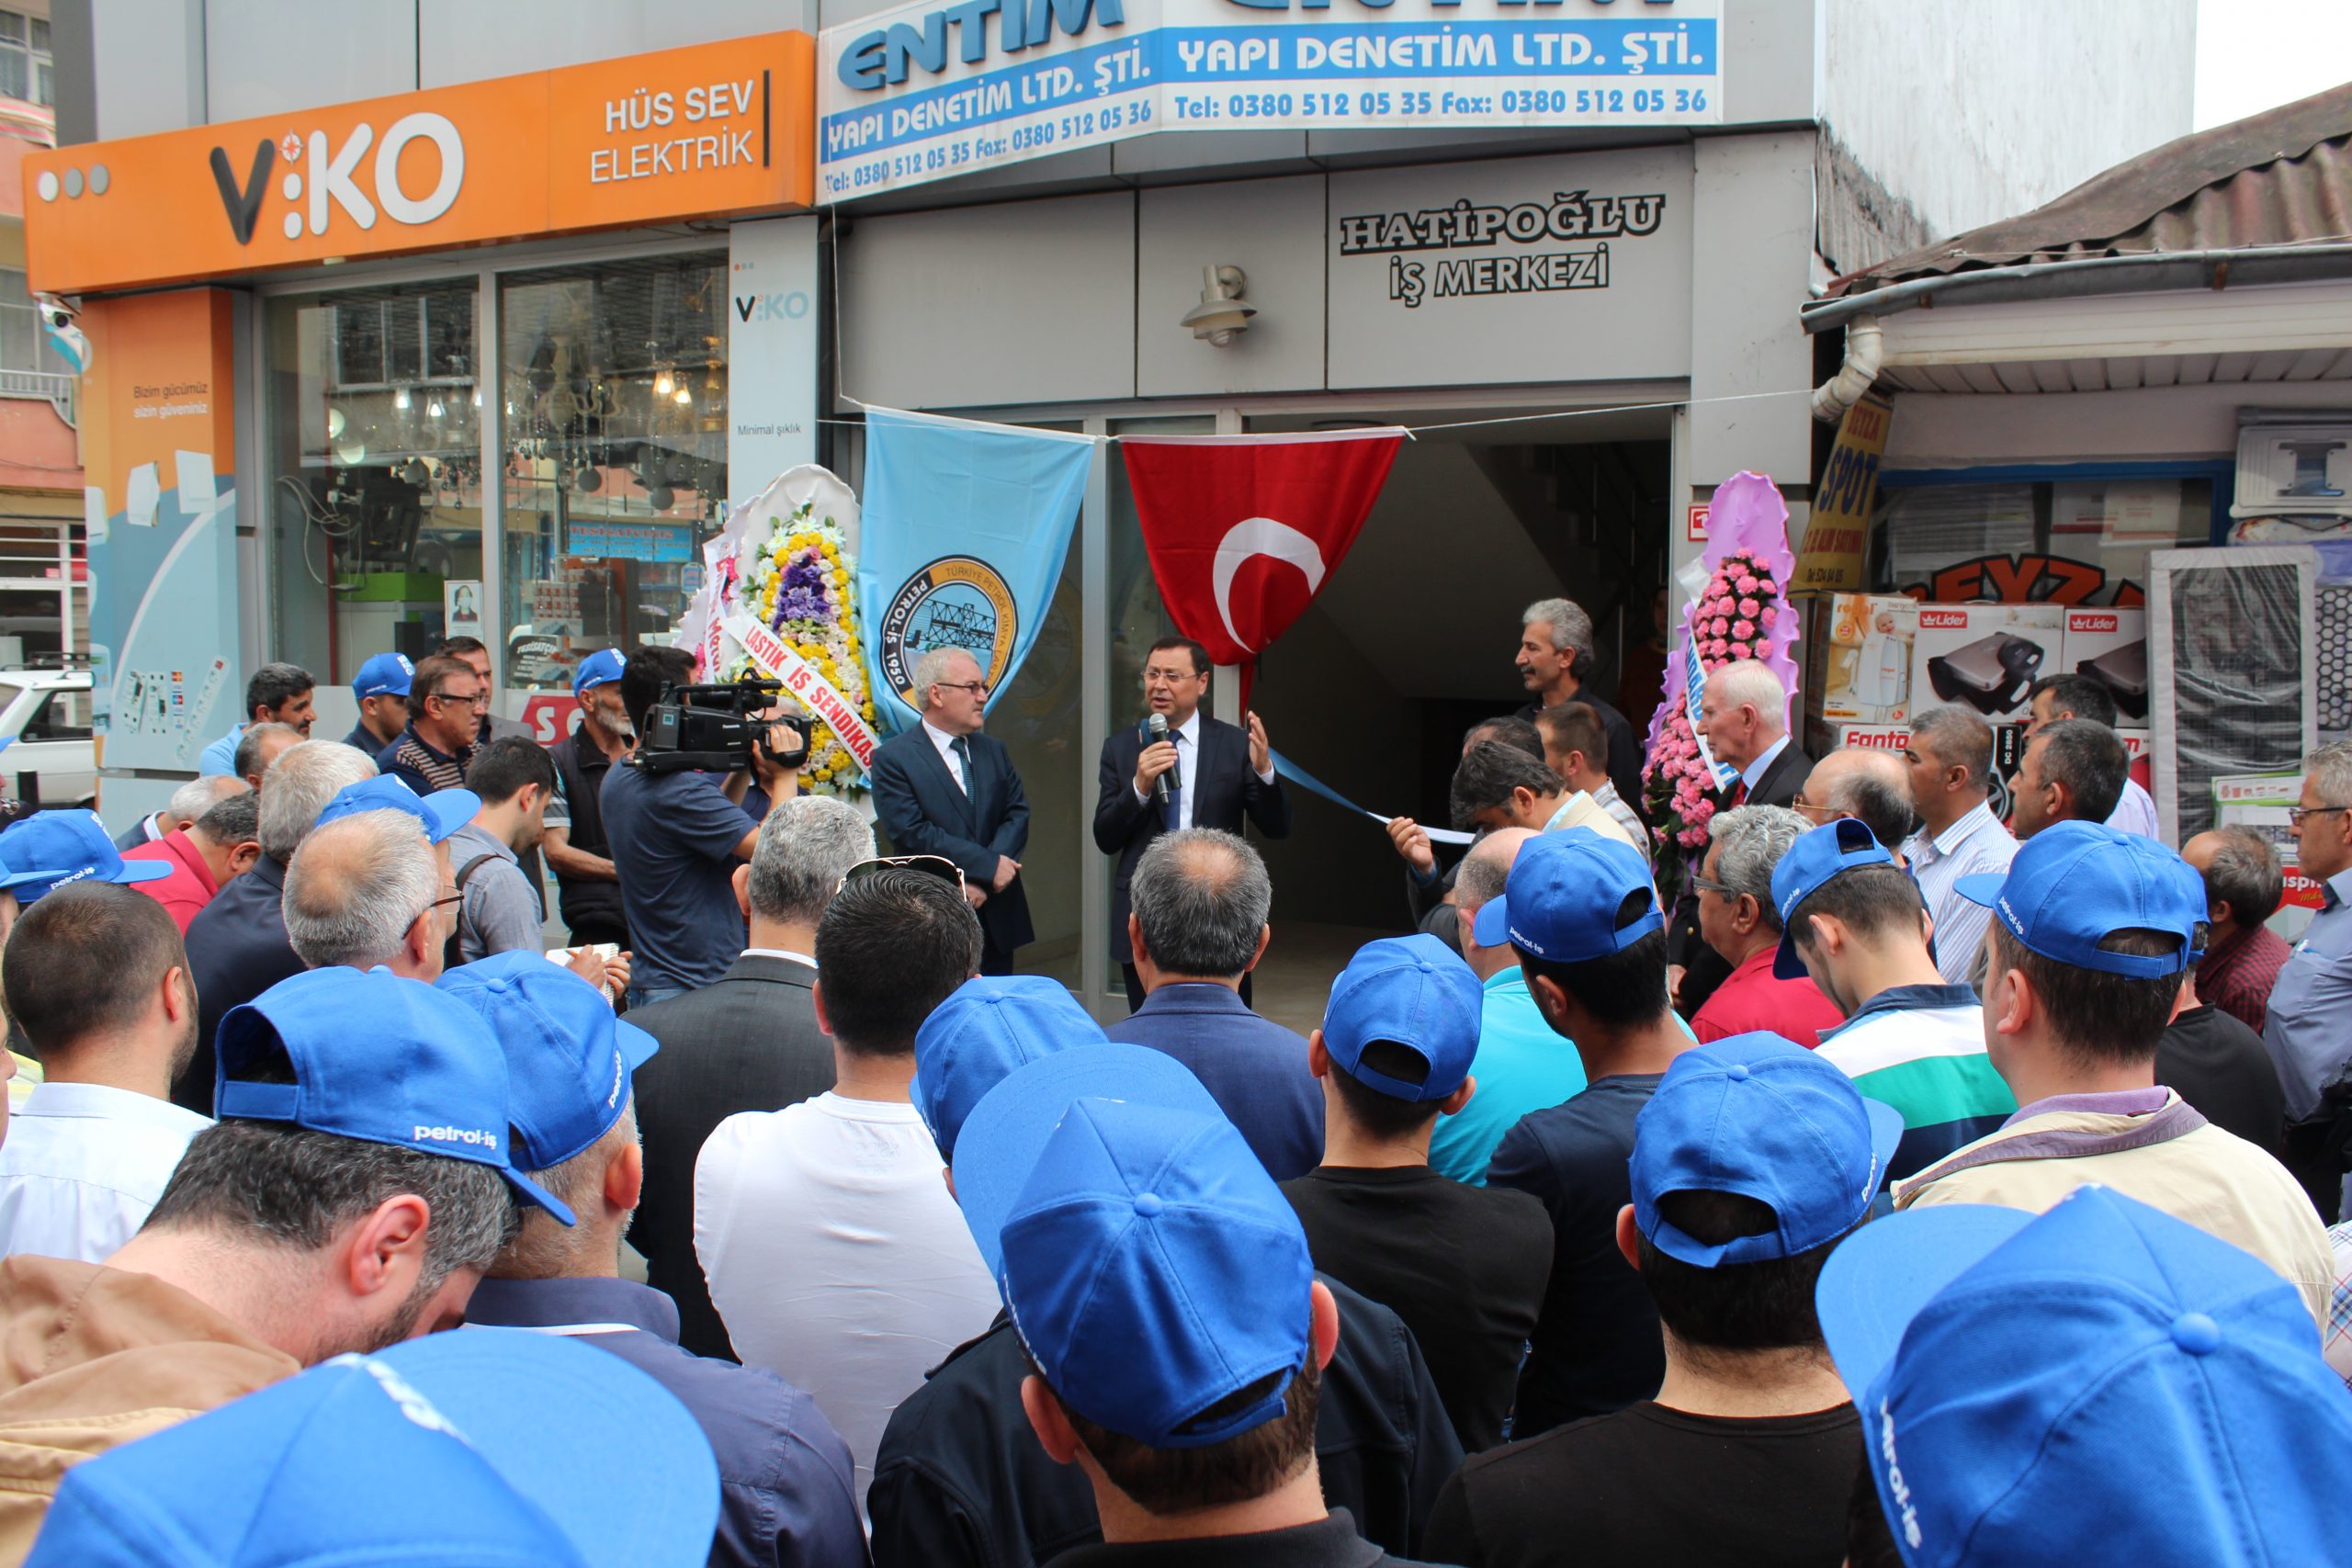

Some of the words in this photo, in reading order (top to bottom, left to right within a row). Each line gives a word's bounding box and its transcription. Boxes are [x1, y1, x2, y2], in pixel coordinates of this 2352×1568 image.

[1178, 38, 1280, 73] YAPI
[1296, 24, 1497, 70] DENETİM
[1512, 33, 1606, 65] LTD.
[1622, 23, 1704, 74] ŞTİ.
[605, 87, 674, 133] HÜS
[684, 79, 754, 122] SEV
[830, 116, 883, 153] YAPI
[892, 79, 1012, 138] DENETİM
[1023, 66, 1083, 104] LTD.
[1094, 39, 1151, 96] ŞTİ.
[1174, 95, 1219, 118] Tel:
[1228, 93, 1293, 118] 0380
[1302, 93, 1350, 117] 512
[1360, 93, 1391, 116] 05
[1401, 92, 1432, 115] 35
[1442, 92, 1492, 116] Fax:
[1501, 90, 1566, 114] 0380
[1576, 89, 1623, 113] 512
[1633, 89, 1665, 112] 05
[1674, 88, 1707, 112] 36
[590, 125, 754, 184] ELEKTRİK
[826, 173, 850, 194] Tel:
[854, 161, 889, 187] 0380
[895, 154, 922, 178] 512
[927, 148, 945, 170] 05
[951, 141, 969, 164] 35
[976, 138, 1008, 161] Fax:
[1012, 122, 1055, 152] 0380
[1061, 114, 1094, 140] 512
[1100, 107, 1122, 130] 05
[1128, 99, 1152, 124] 36
[1340, 190, 1667, 256] HATİPOĞLU
[1389, 254, 1426, 309] İŞ
[1433, 242, 1610, 299] MERKEZİ
[133, 385, 160, 399] Bizim
[738, 424, 775, 436] Minimal
[775, 423, 802, 437] şıklık
[1818, 443, 1880, 517] SPOT
[946, 566, 983, 581] TÜRKİYE
[982, 576, 1007, 612] PETROL
[1902, 553, 2145, 605] EYZ
[887, 579, 928, 645] PETROL-İŞ
[1936, 614, 1966, 626] Lider
[2085, 617, 2116, 630] Lider
[886, 652, 906, 685] 1950
[744, 626, 789, 671] LASTİK
[786, 665, 812, 692] İŞ
[809, 685, 874, 768] SENDİKAS
[1847, 730, 1910, 750] Fanto
[414, 1123, 498, 1150] petrol-iş
